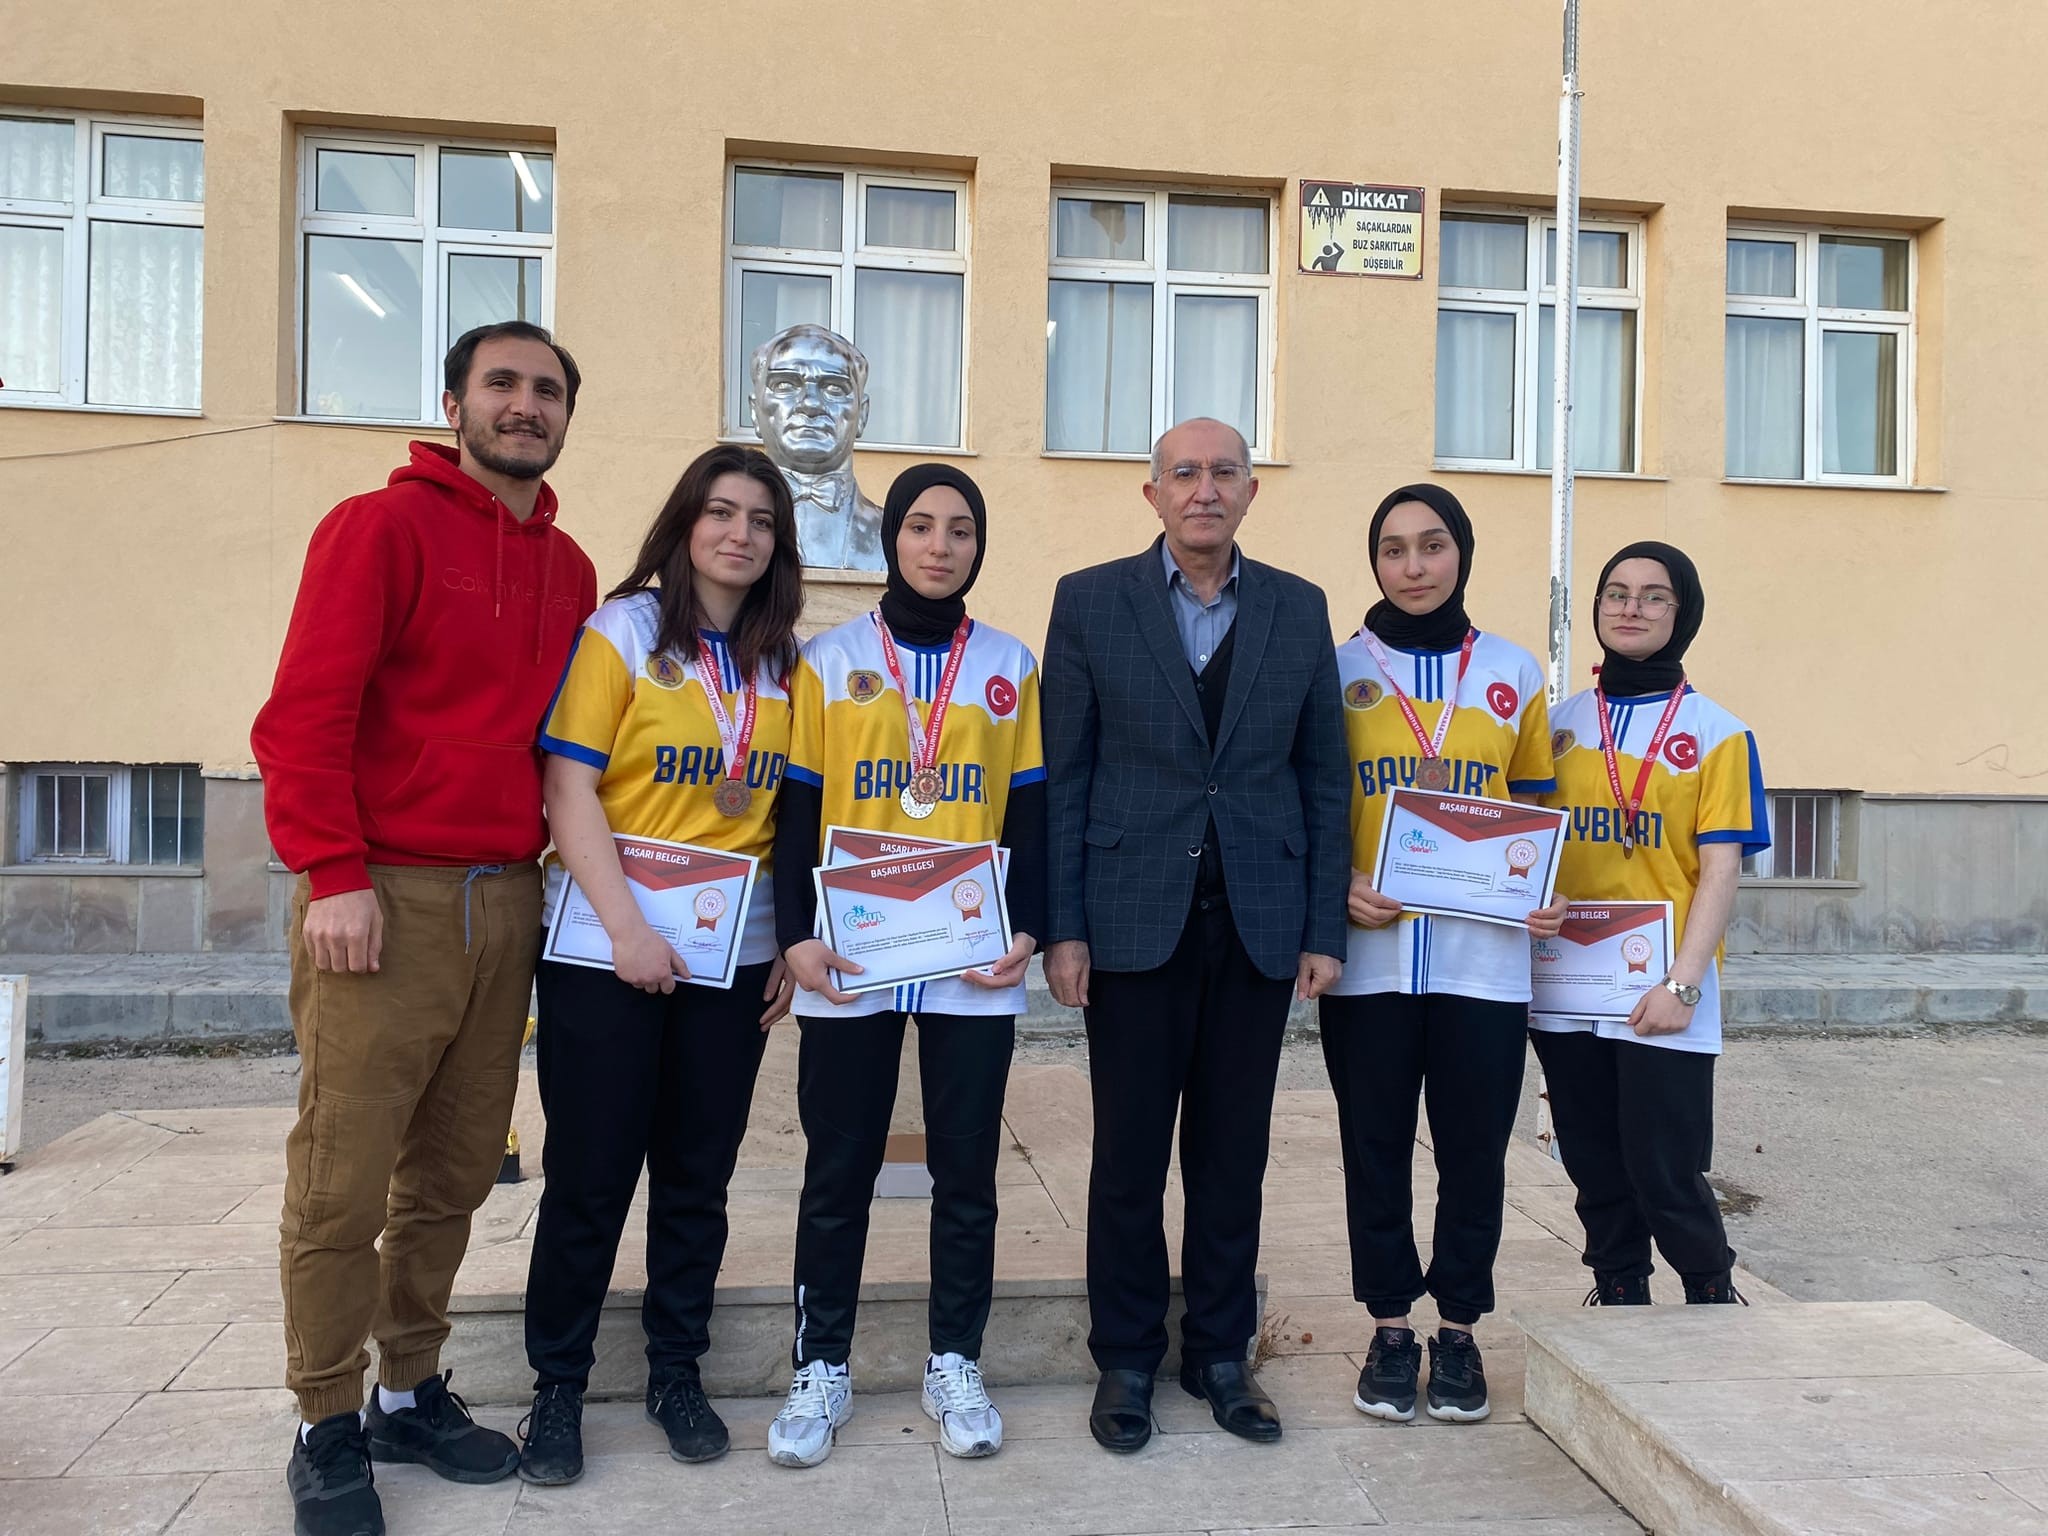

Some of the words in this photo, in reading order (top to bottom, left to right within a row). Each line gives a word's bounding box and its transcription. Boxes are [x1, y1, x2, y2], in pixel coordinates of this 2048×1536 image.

[1341, 187, 1408, 209] DİKKAT
[1356, 221, 1412, 234] SAÇAKLARDAN
[1353, 239, 1368, 250] BUZ
[1370, 240, 1415, 253] SARKITLARI
[1363, 257, 1403, 271] DÜŞEBİLİR
[442, 567, 507, 600] Calvn
[653, 745, 785, 791] BAYUR
[1357, 756, 1499, 796] BAYURT
[854, 758, 987, 804] BAYUR
[1439, 802, 1468, 814] BAŞARI
[1469, 805, 1502, 819] BELGESİ
[655, 851, 690, 866] BELGESİ
[870, 865, 901, 879] BAŞARI
[901, 858, 935, 873] BELGESİ
[1580, 909, 1610, 920] BELGESİ
